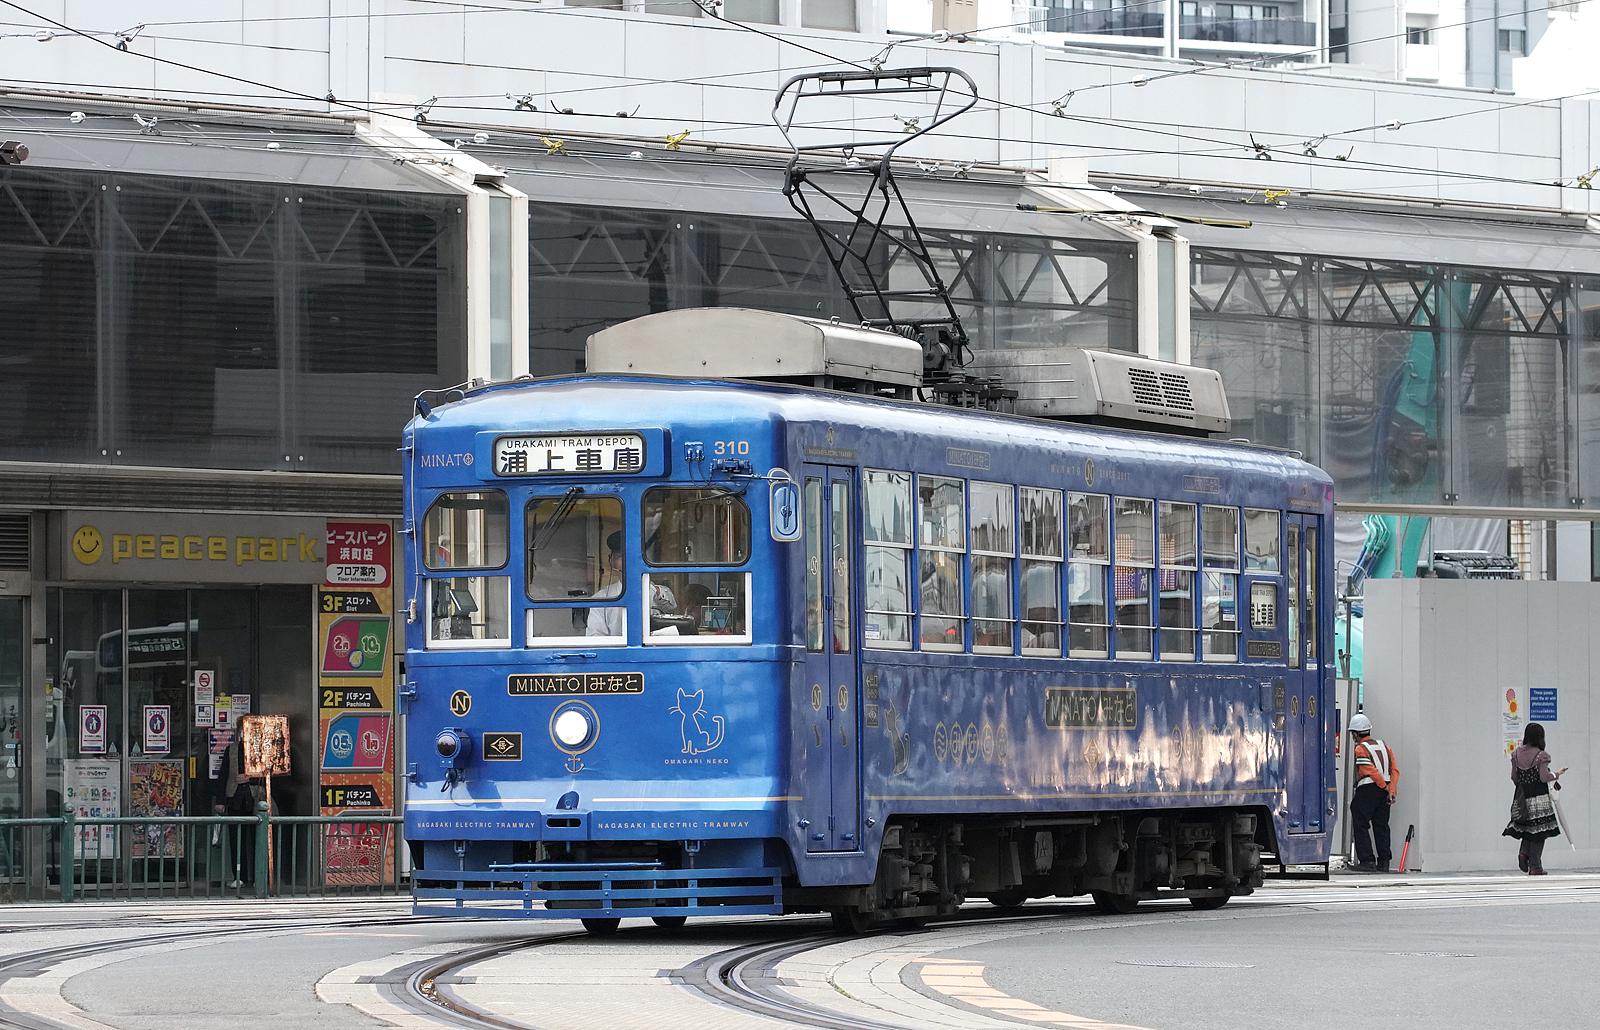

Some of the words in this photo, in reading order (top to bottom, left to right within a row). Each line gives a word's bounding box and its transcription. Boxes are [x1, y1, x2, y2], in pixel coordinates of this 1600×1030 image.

[506, 439, 557, 449] URAKAMI
[562, 438, 592, 448] TRAM
[597, 437, 634, 447] DEPOT
[714, 440, 749, 455] 310
[421, 452, 474, 468] MINATO
[500, 447, 640, 473] 浦上車庫
[326, 529, 387, 546] ピースパーク
[112, 533, 227, 564] peace
[236, 533, 318, 566] park
[340, 547, 374, 561] 浜町店
[336, 566, 376, 577] フロア案内
[323, 594, 343, 612] 3F
[346, 597, 371, 605] スロット
[516, 677, 580, 692] MINATO
[589, 675, 638, 692] みなと
[323, 690, 343, 707] 2F
[346, 692, 371, 701] パチンコ
[1051, 695, 1097, 721] MINATO
[1103, 694, 1133, 723] みなと
[325, 788, 344, 806] 1F
[346, 790, 372, 799] パチンコ
